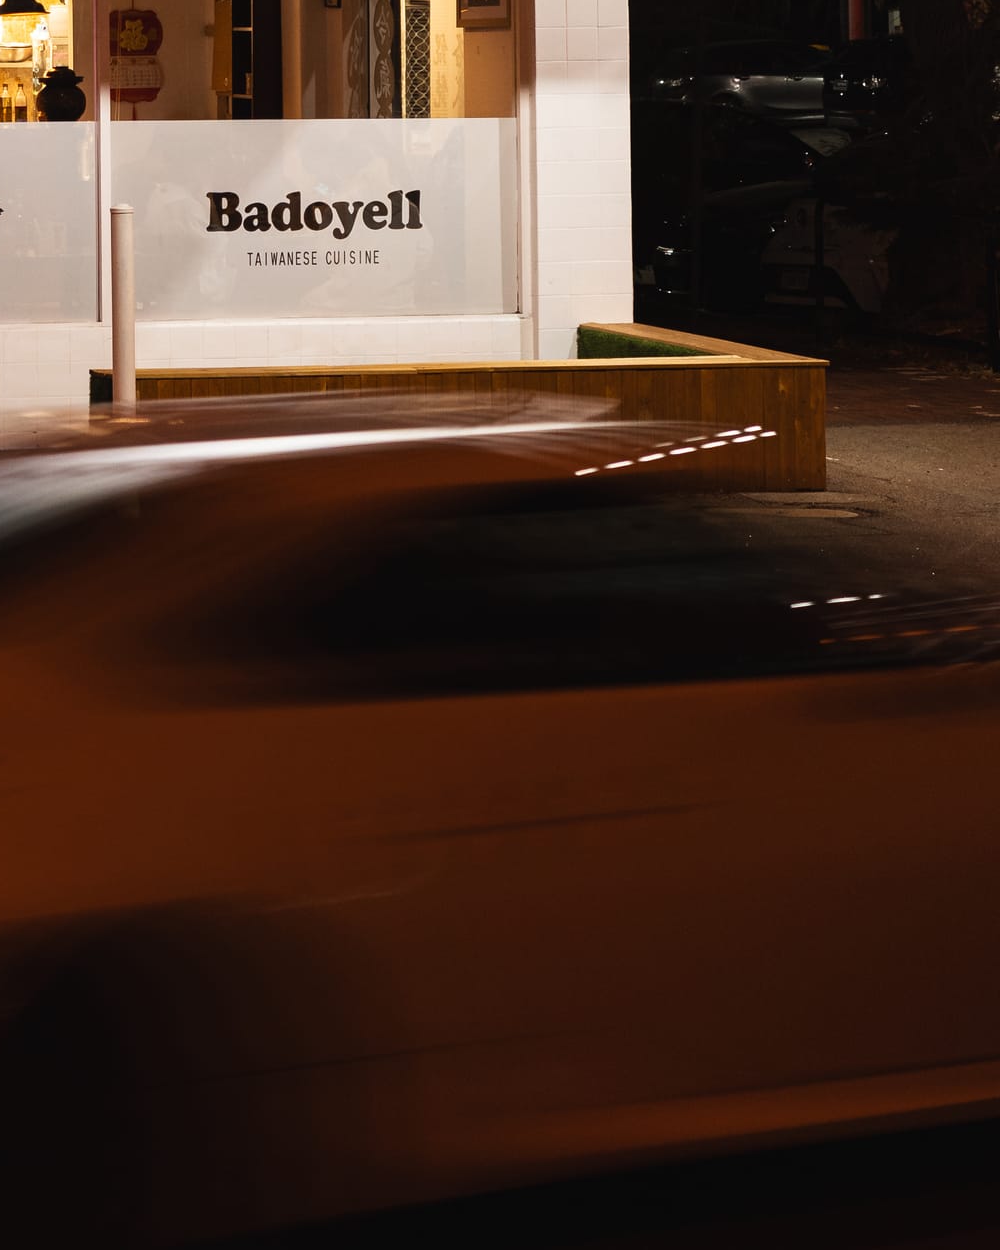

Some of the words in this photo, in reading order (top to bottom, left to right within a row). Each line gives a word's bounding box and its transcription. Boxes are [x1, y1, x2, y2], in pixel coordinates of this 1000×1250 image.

[206, 189, 423, 240] Badoyell
[247, 251, 318, 267] TAIWANESE
[325, 250, 380, 265] CUISINE
